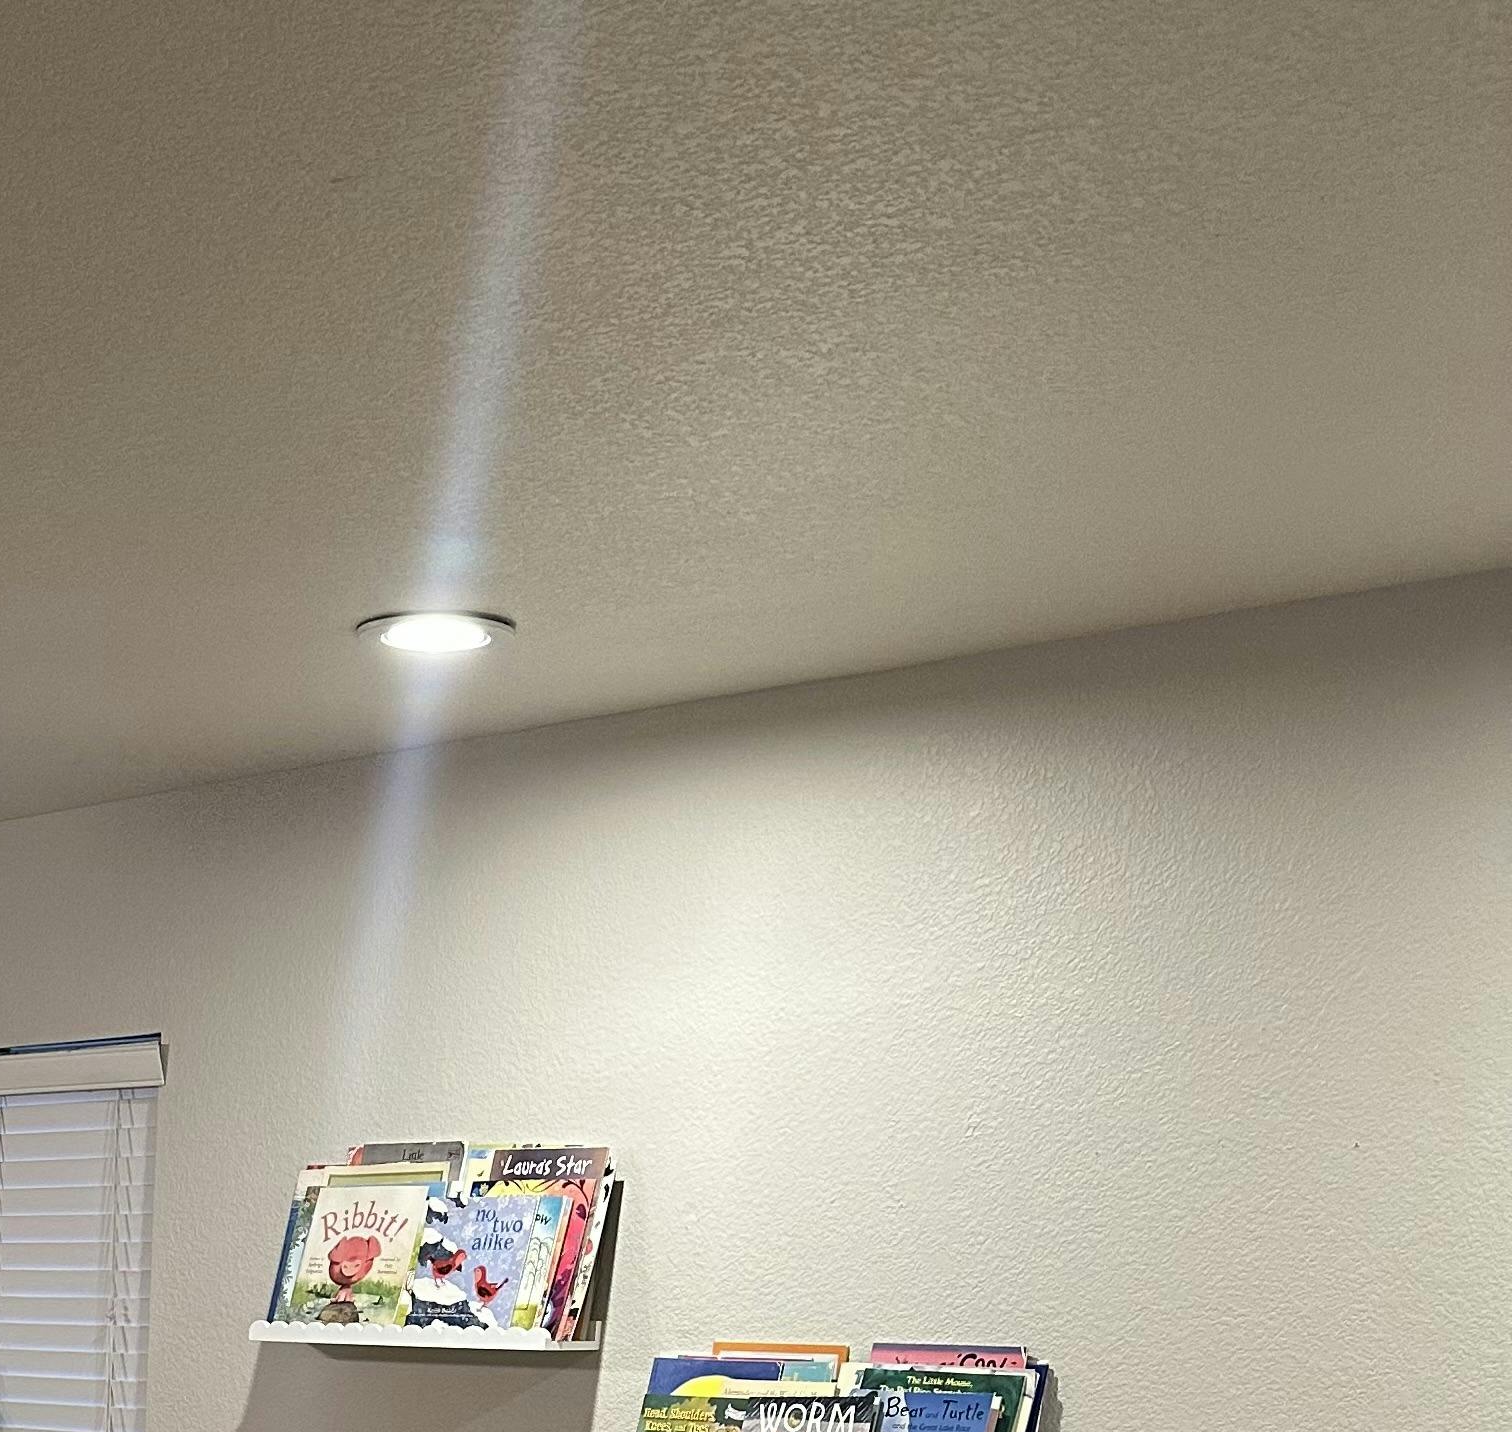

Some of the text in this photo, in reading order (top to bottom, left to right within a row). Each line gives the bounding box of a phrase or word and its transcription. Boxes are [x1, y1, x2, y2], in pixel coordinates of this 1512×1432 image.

[555, 1155, 592, 1176] Star
[321, 1200, 408, 1243] Ribbit!
[475, 1209, 496, 1222] no
[492, 1216, 523, 1234] two
[471, 1232, 515, 1251] alike
[907, 1376, 922, 1385] The
[923, 1376, 945, 1386] Little
[885, 1396, 984, 1422] Bear and Turtle
